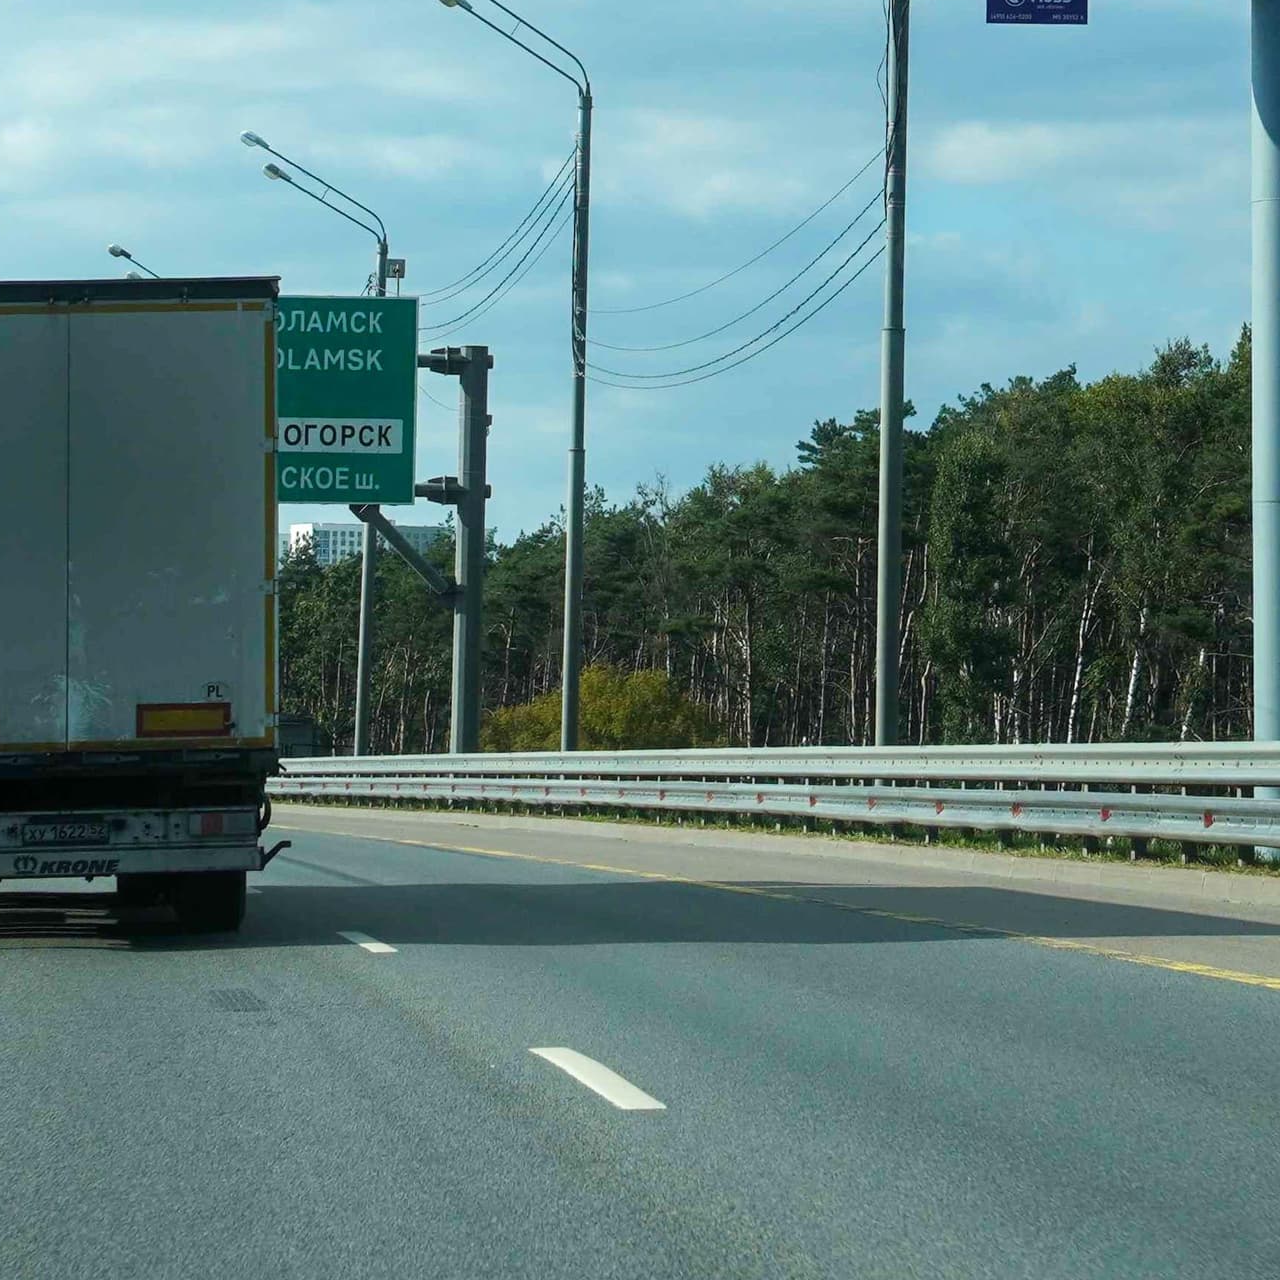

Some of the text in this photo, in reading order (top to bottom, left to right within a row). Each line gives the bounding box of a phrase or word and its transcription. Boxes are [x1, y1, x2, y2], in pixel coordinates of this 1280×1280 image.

[284, 424, 392, 447] ОГОРСК
[281, 466, 380, 490] СКОЕ ш.
[207, 685, 223, 698] PL
[39, 859, 120, 874] KRONE
